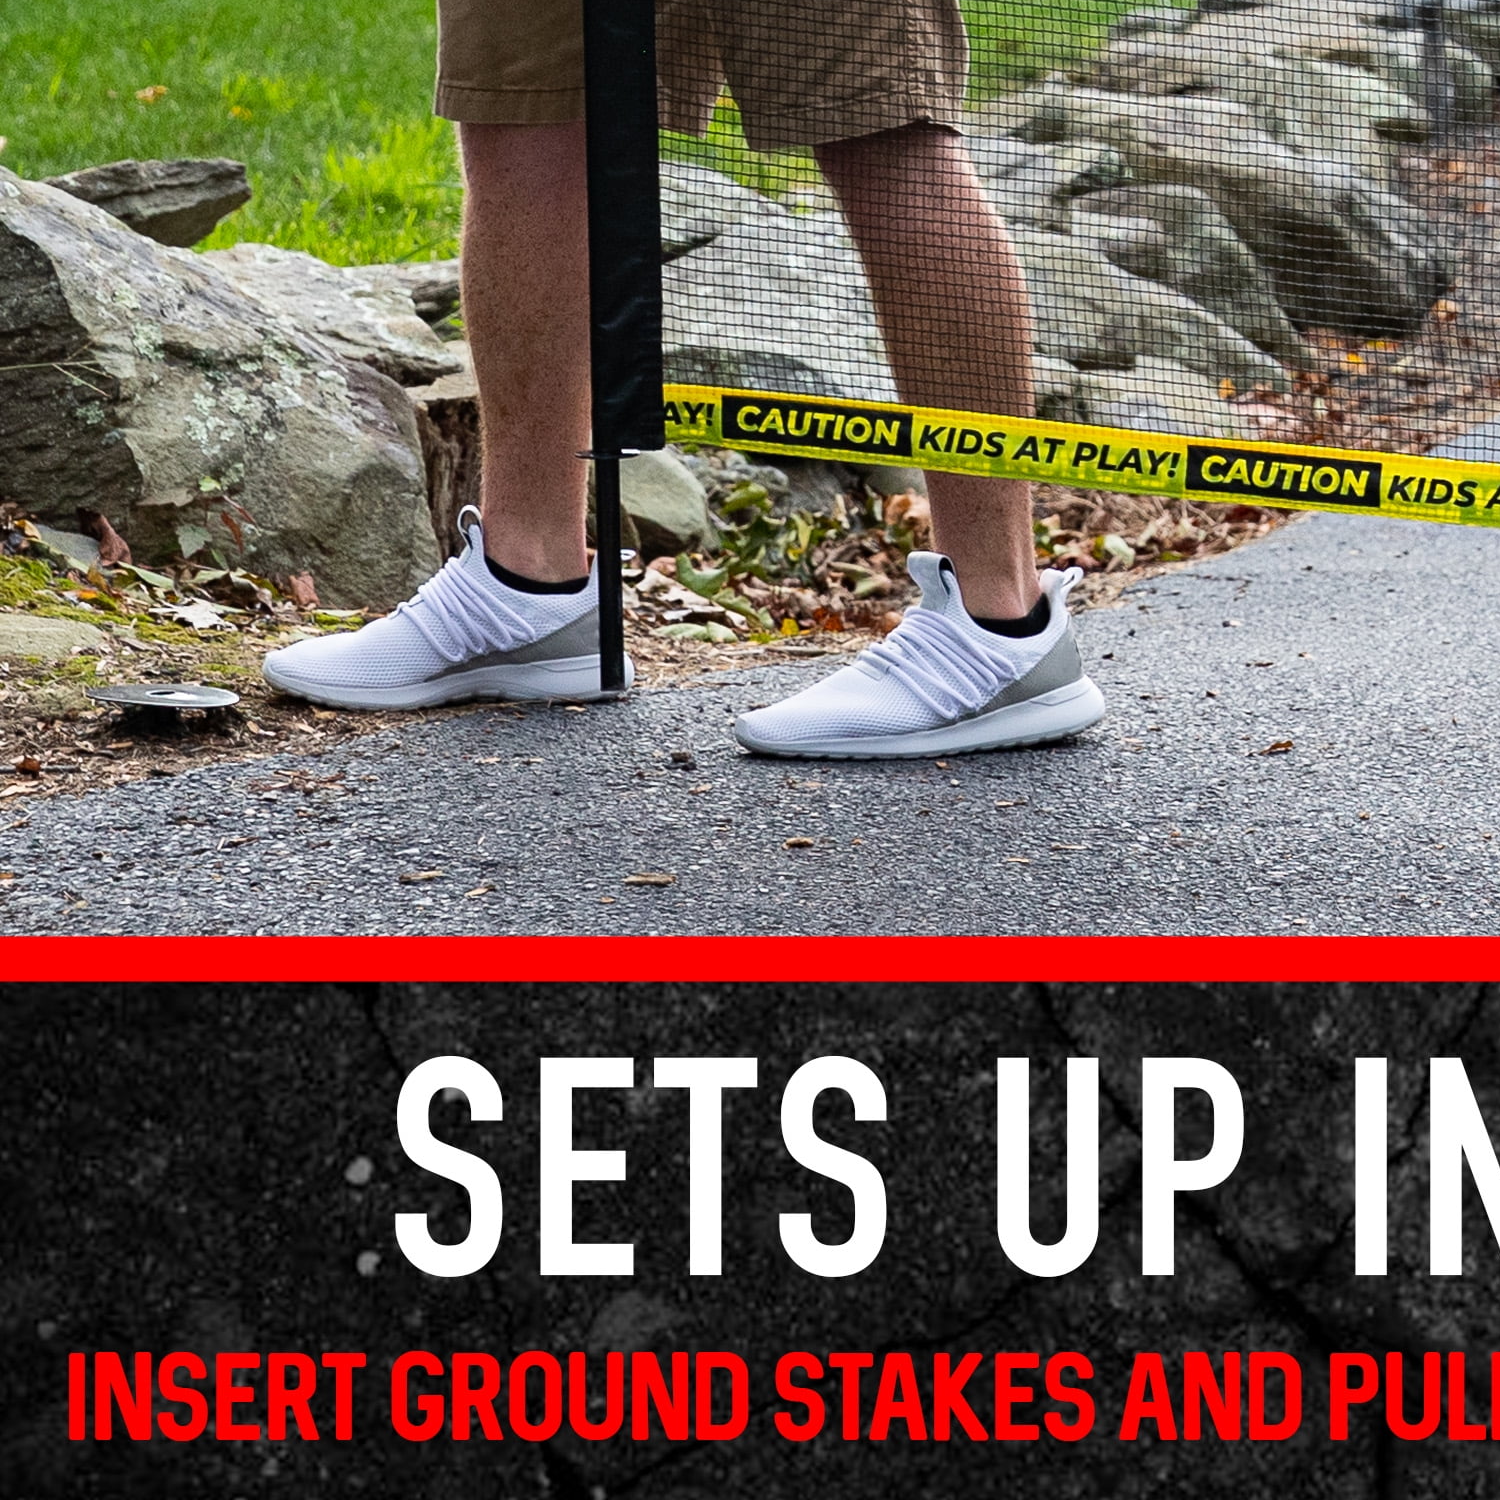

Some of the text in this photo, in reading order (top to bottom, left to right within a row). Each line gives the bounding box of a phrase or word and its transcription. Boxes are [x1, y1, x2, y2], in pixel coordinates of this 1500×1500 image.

[736, 404, 900, 447] CAUTION
[918, 424, 1006, 458] KIDS
[1012, 435, 1066, 465] AT
[1071, 441, 1182, 479] PLAY!
[1200, 454, 1369, 497] CAUTION
[1387, 474, 1478, 507] KIDS
